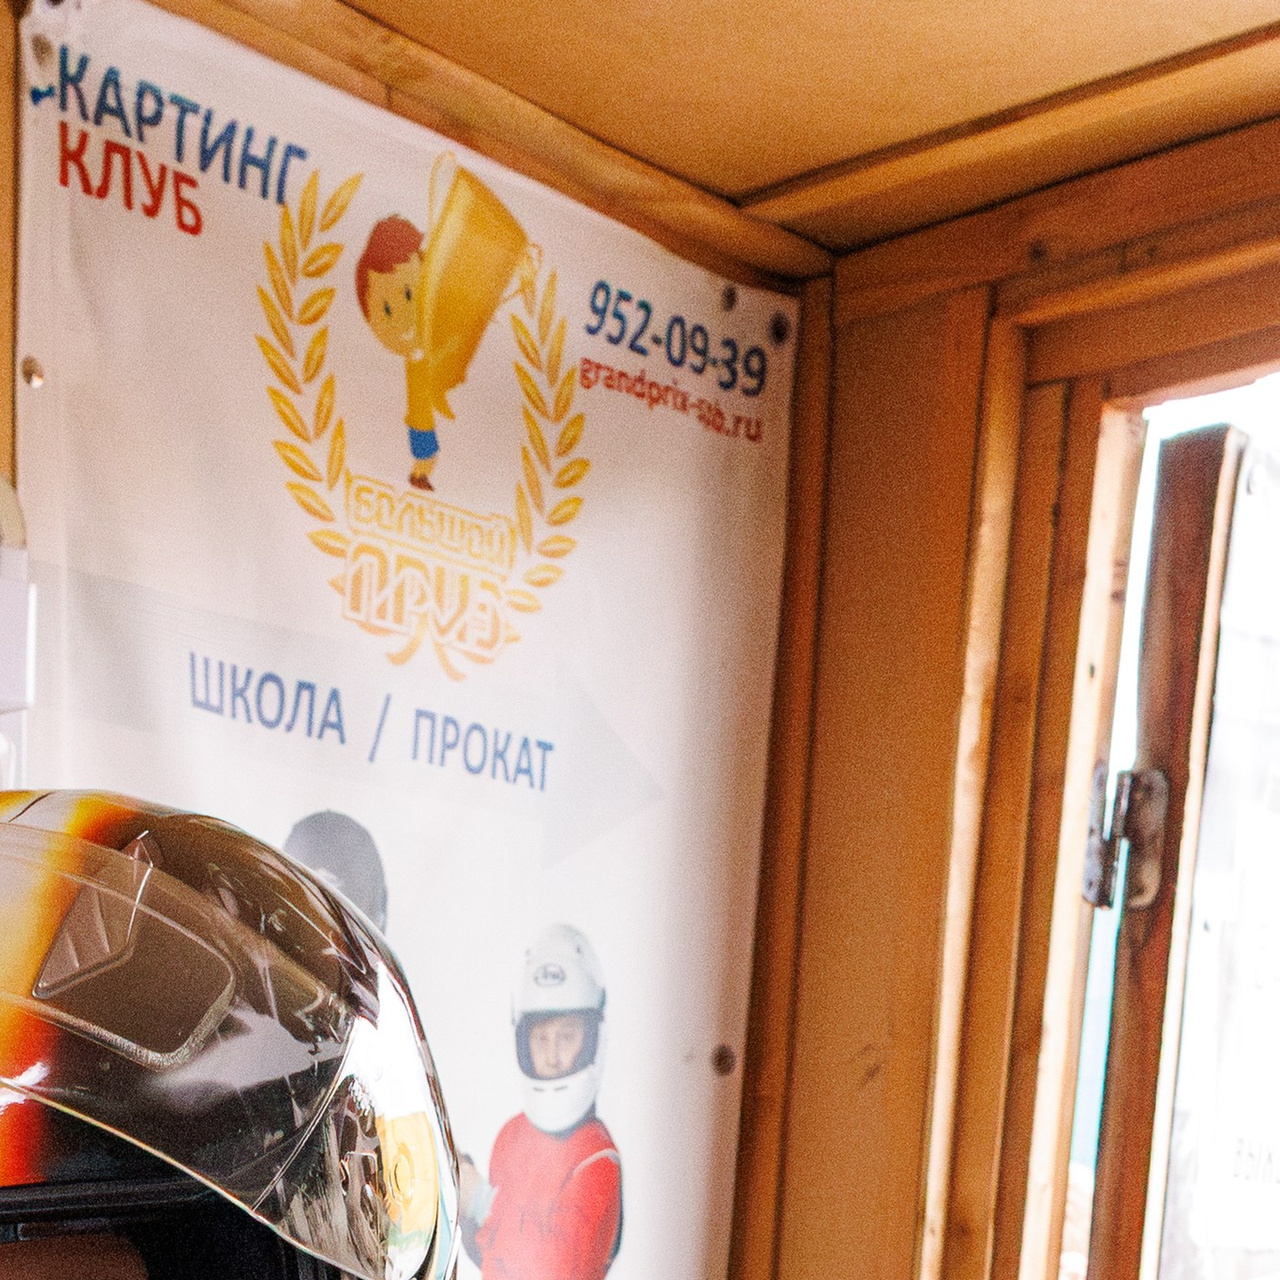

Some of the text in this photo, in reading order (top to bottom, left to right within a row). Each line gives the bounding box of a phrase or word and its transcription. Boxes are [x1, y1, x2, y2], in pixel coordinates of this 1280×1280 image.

[58, 120, 204, 236] КЛУБ
[59, 44, 308, 205] КАРТИНГ
[584, 279, 768, 398] 952-09-39
[189, 651, 346, 745] ШКОЛА
[411, 707, 554, 791] ПРОКАТ
